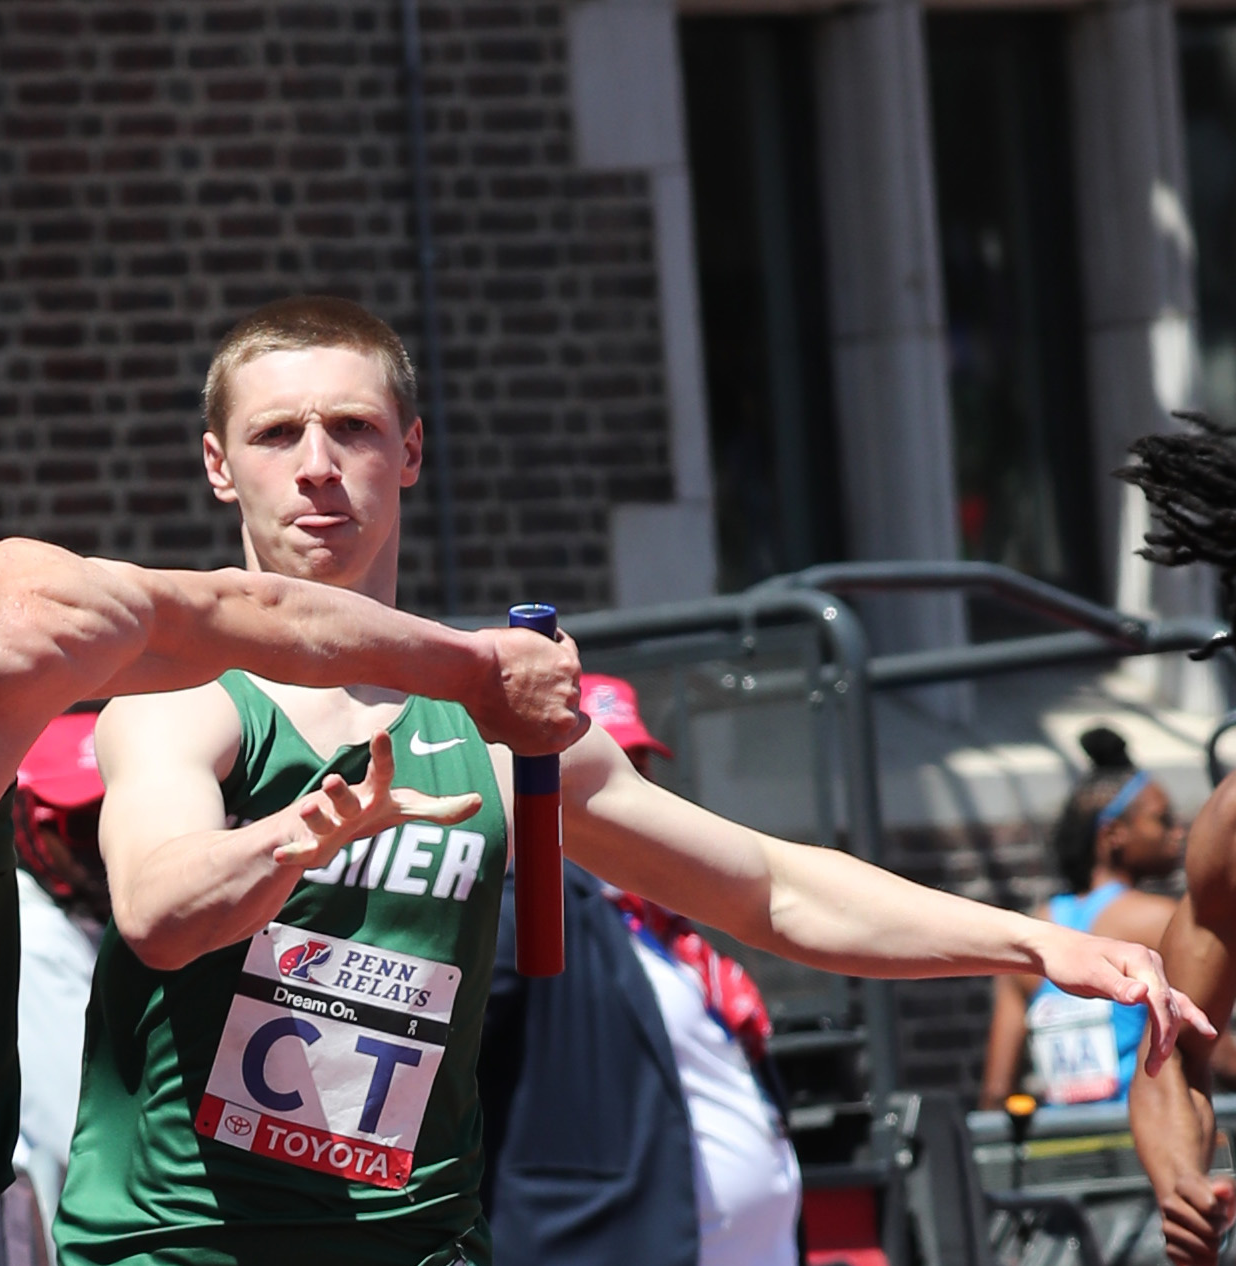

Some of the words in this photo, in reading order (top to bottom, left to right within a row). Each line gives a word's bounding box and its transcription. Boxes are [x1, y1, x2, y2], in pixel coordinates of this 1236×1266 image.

[302, 821, 486, 901] NER
[341, 950, 418, 982] PENN
[273, 987, 327, 1013] Dream
[330, 1001, 358, 1021] On.
[333, 970, 432, 1008] RELAYS
[266, 1124, 389, 1179] TOYOTA
